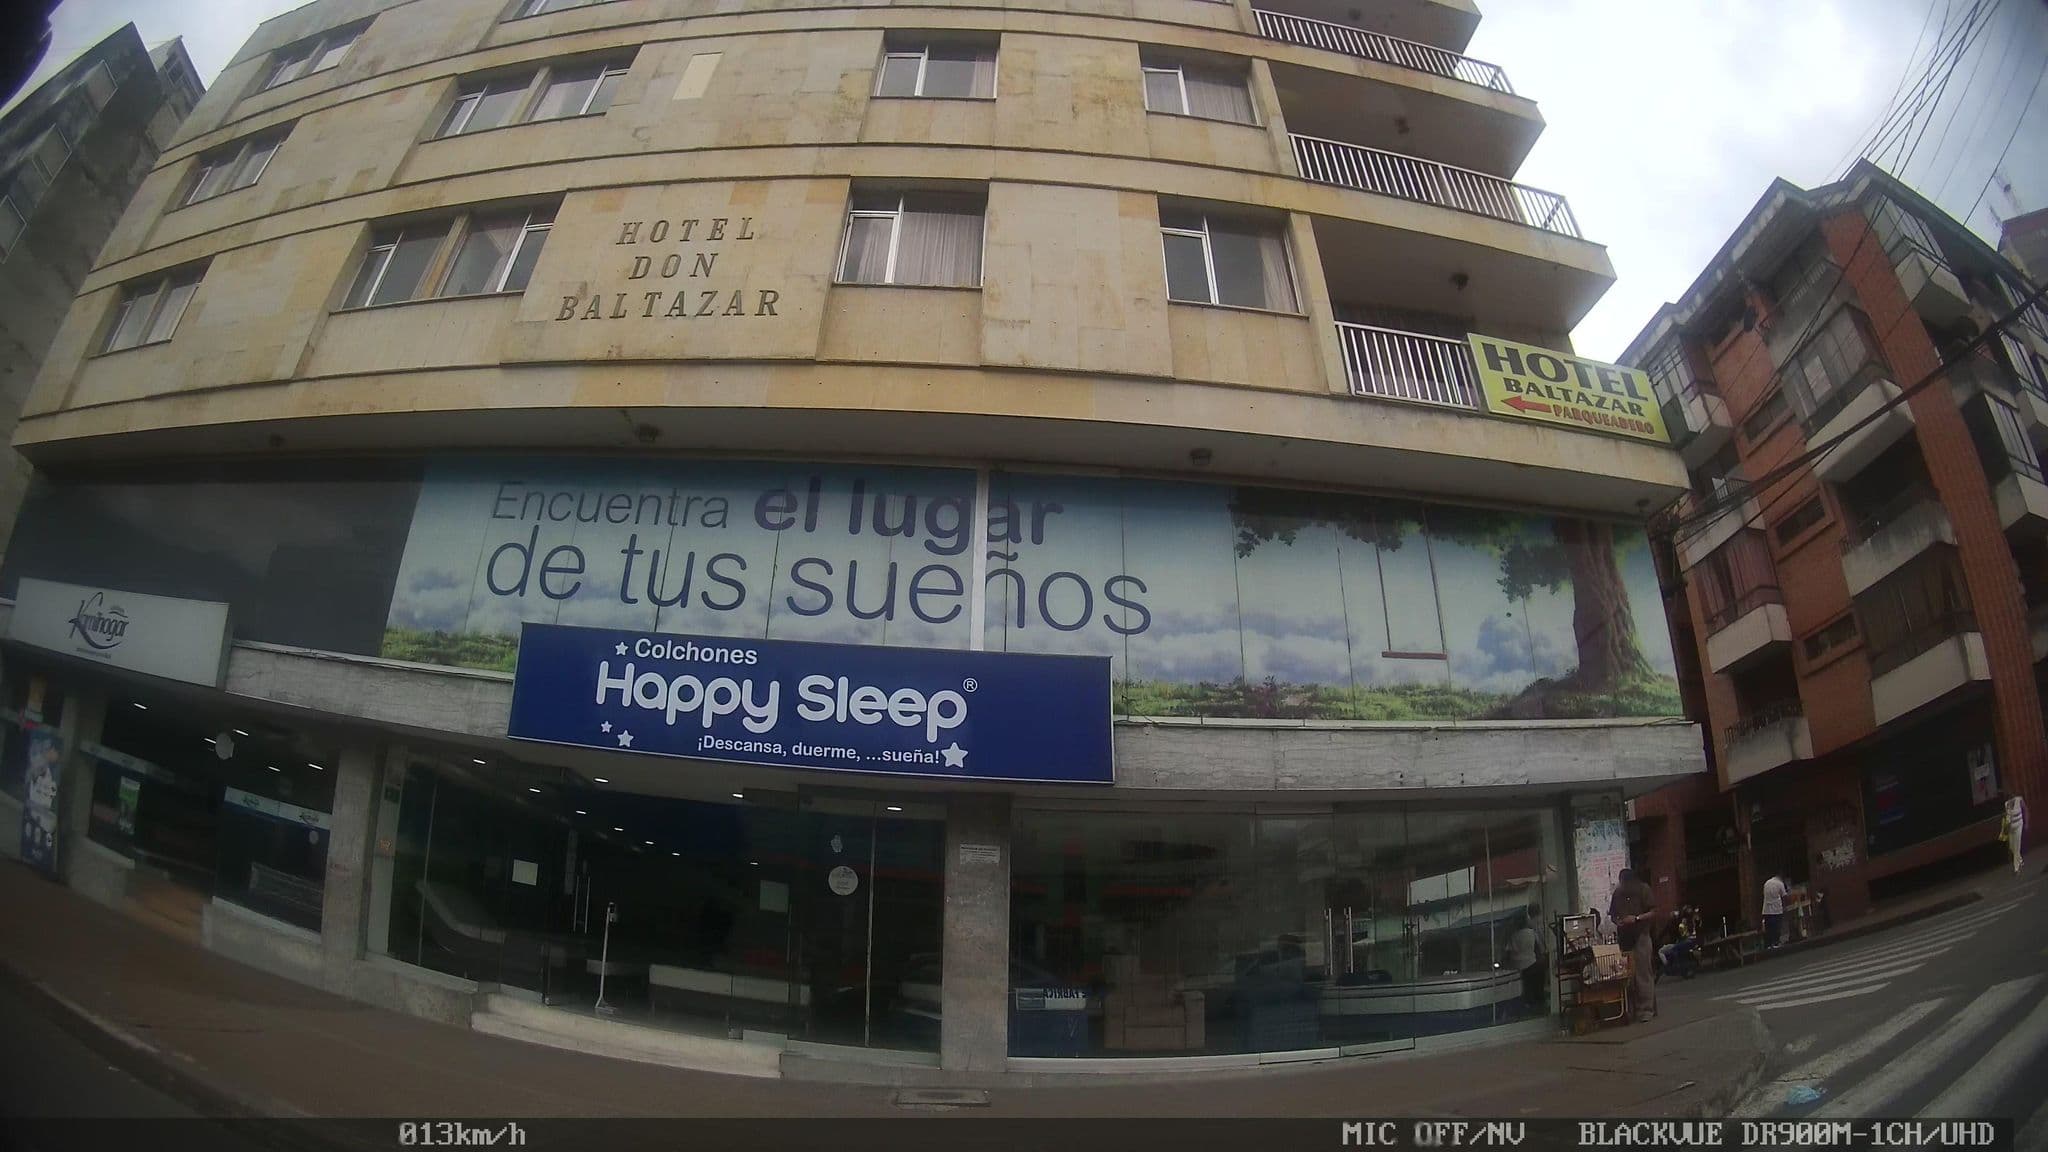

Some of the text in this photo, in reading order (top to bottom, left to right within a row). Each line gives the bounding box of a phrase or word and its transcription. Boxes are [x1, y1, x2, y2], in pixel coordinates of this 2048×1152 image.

[616, 217, 754, 245] HOTEL
[628, 253, 718, 280] DON
[555, 290, 780, 321] BALTAZAR
[1481, 342, 1649, 402] HOTEL
[1503, 377, 1645, 417] BALTAZAR
[1552, 404, 1655, 435] PARQUEADERO
[491, 476, 1064, 556] Encuentra el lugar
[486, 524, 1152, 636] de tus sueños
[634, 638, 758, 665] Colchones
[596, 660, 968, 742] Happy Sleep
[698, 736, 940, 765] ¡Descansa, duerme, ...sueña!
